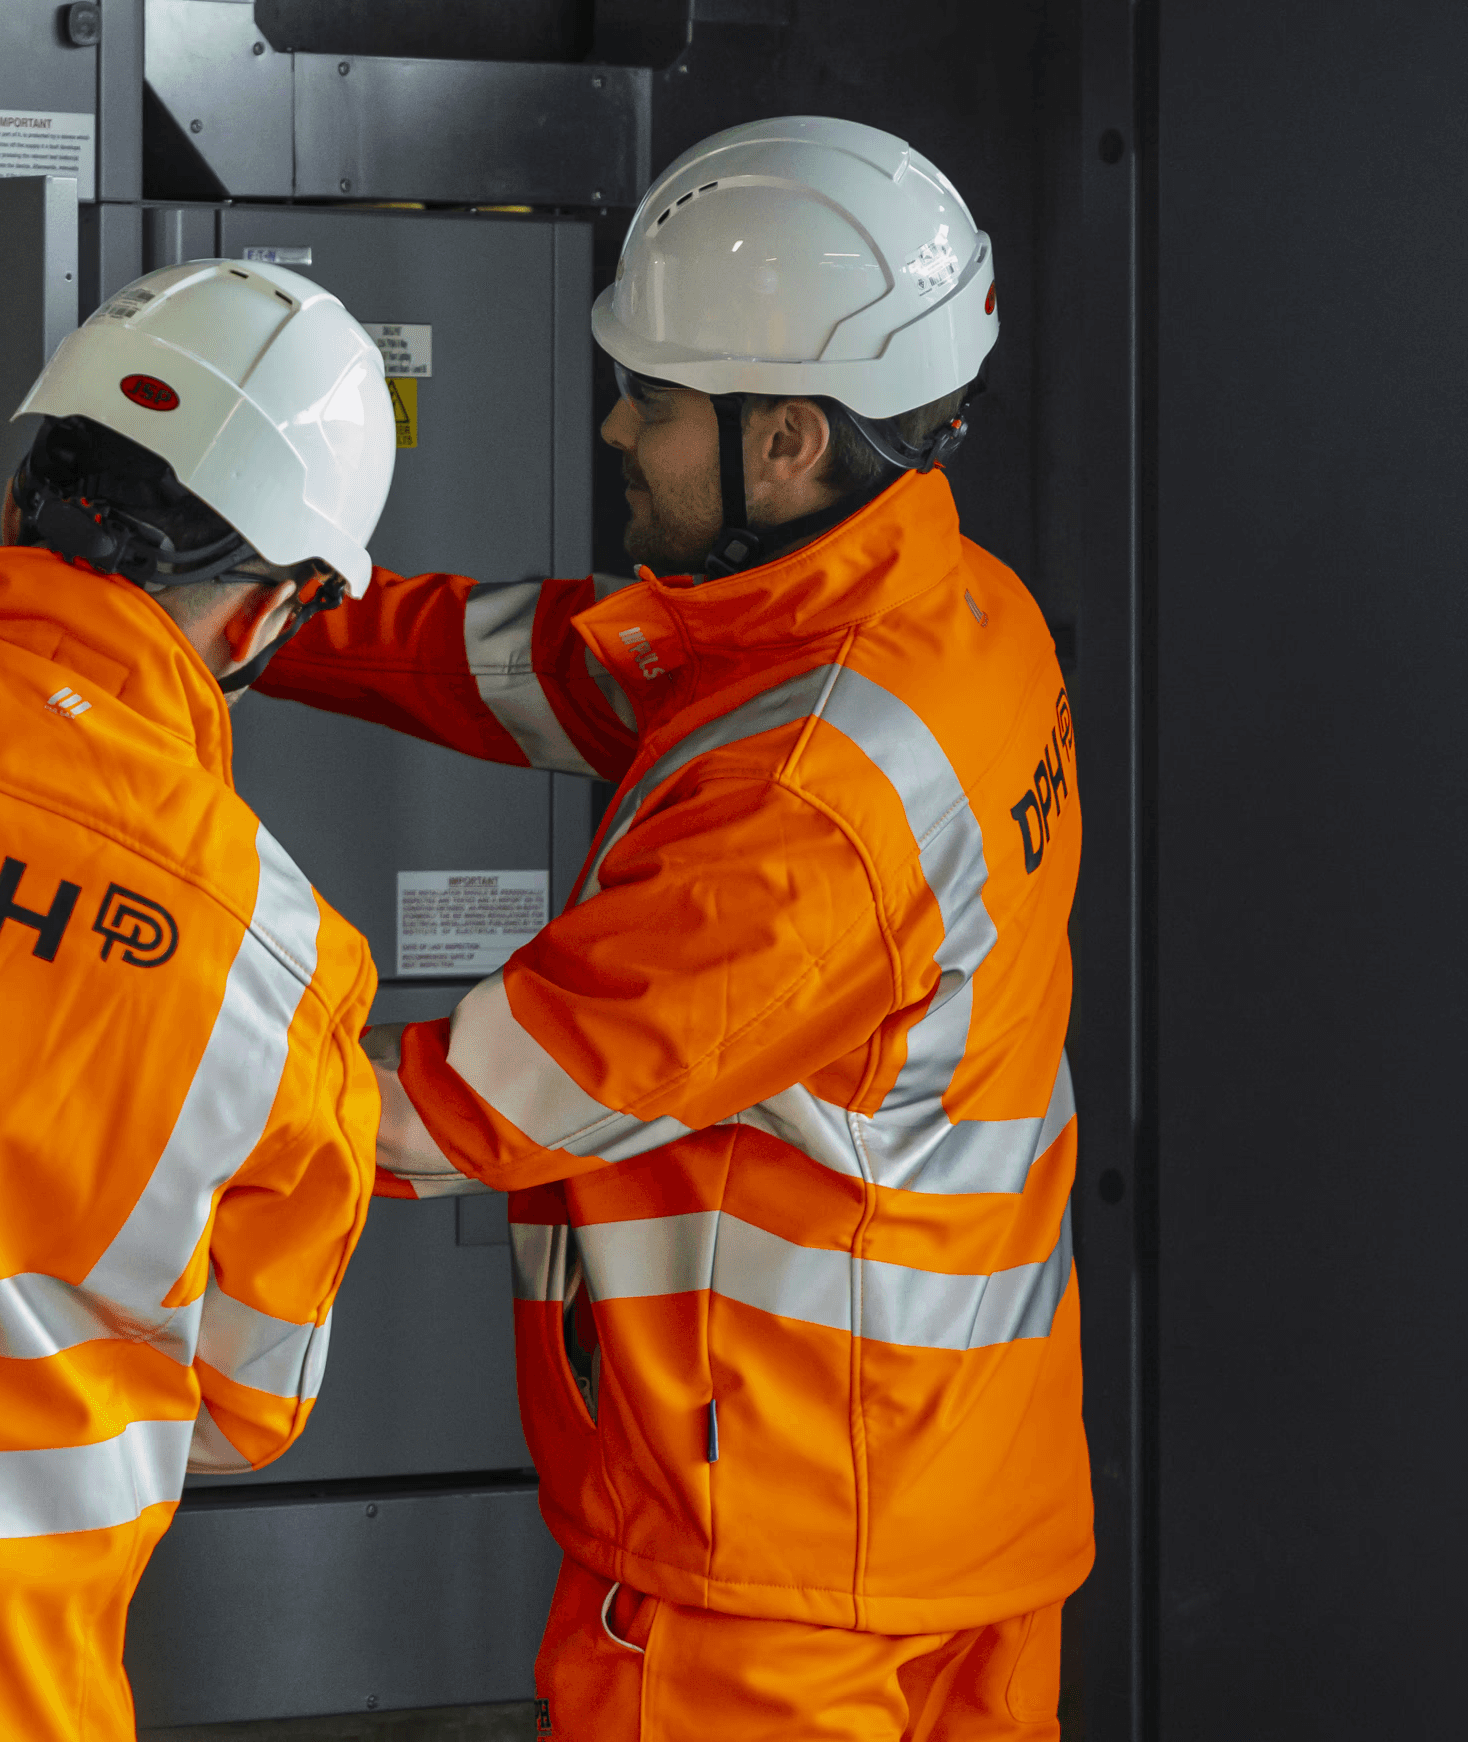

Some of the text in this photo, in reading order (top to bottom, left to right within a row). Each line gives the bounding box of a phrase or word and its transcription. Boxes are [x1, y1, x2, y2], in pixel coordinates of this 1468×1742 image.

[128, 380, 171, 403] JSP
[1010, 725, 1069, 875] DPH
[449, 876, 498, 886] IMPORTANT
